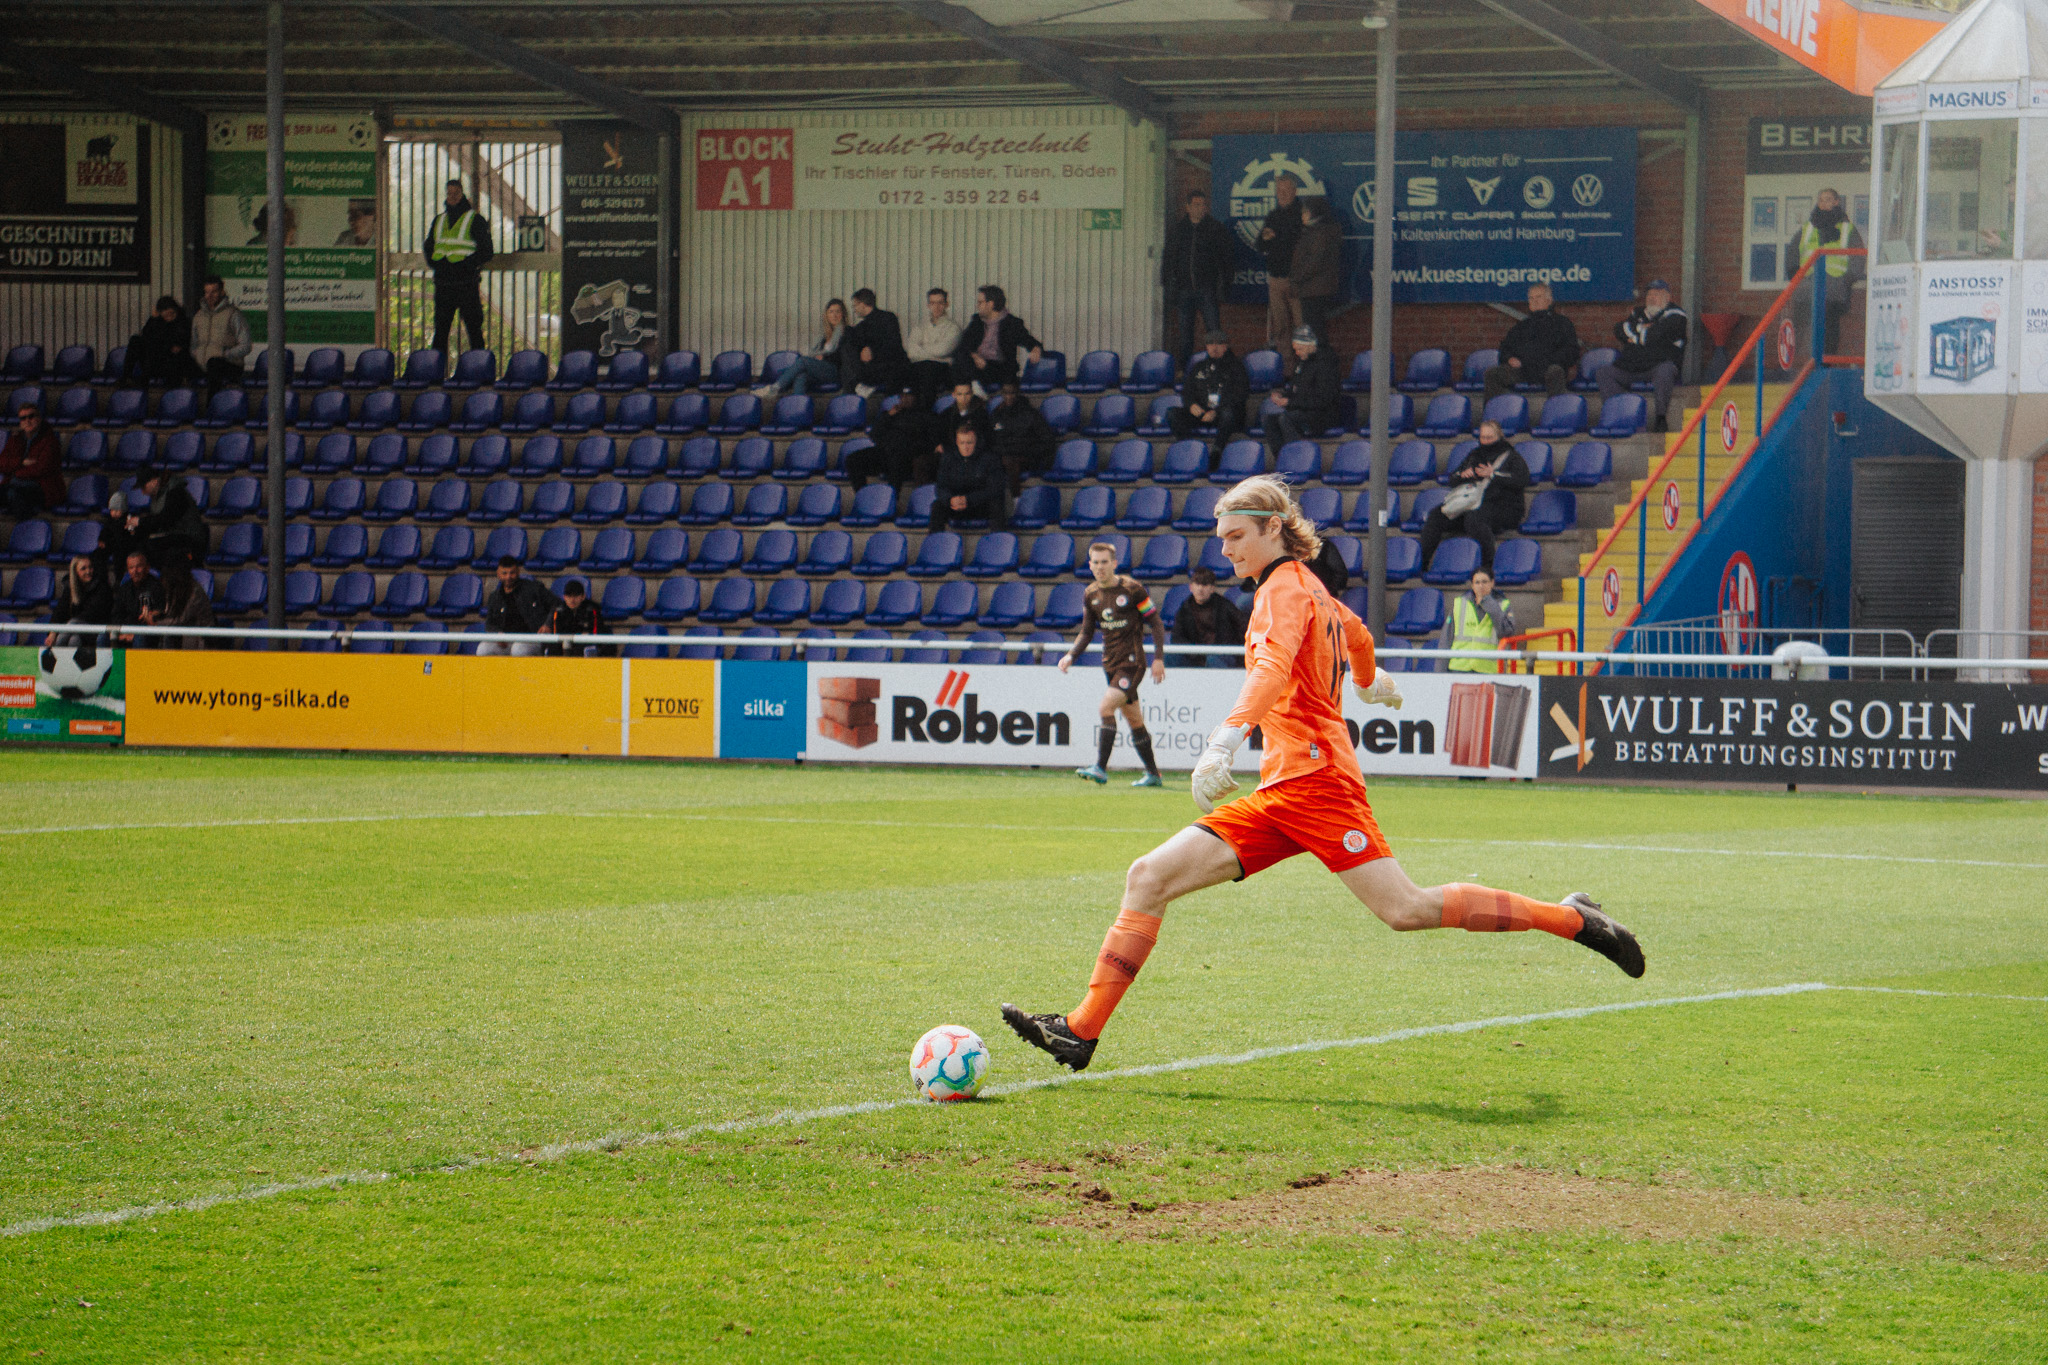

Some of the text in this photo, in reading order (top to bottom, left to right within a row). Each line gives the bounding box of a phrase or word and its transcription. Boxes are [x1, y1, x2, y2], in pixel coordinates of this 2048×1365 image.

[1929, 90, 2007, 108] MAGNUS
[315, 123, 338, 135] LIGA
[1760, 123, 1872, 147] BEHR
[700, 136, 790, 161] BLOCK
[830, 132, 1091, 161] Stuht-Holztechnik
[1430, 153, 1521, 168] Ihr Partner für
[805, 166, 827, 180] Ihr
[832, 164, 897, 180] Tischler
[903, 164, 925, 179] für
[931, 164, 997, 180] Fenster,
[1003, 163, 1055, 180] Türen,
[293, 175, 364, 191] Pflegeteam
[719, 166, 771, 206] A1
[878, 190, 924, 204] 0172
[943, 190, 979, 204] 359
[986, 190, 1009, 203] 22
[1016, 189, 1040, 203] 64
[1397, 211, 1448, 221] SEAT
[1, 226, 135, 245] GESCHNITTEN
[520, 226, 544, 250] 10
[1401, 228, 1483, 242] Kaltenkirchen
[1488, 228, 1512, 240] und
[1516, 227, 1576, 243] Hamburg
[9, 247, 113, 267] UND DRIN!
[304, 251, 373, 266] Krankenpflege
[235, 263, 254, 275] und
[1928, 276, 2004, 290] ANSTOSS?
[154, 689, 350, 712] www.ytong-silka.de
[643, 698, 699, 715] YTONG
[744, 699, 784, 717] silka
[891, 671, 1071, 746] Röben
[1614, 740, 1957, 772] BESTATTUNGSINSTITUT
